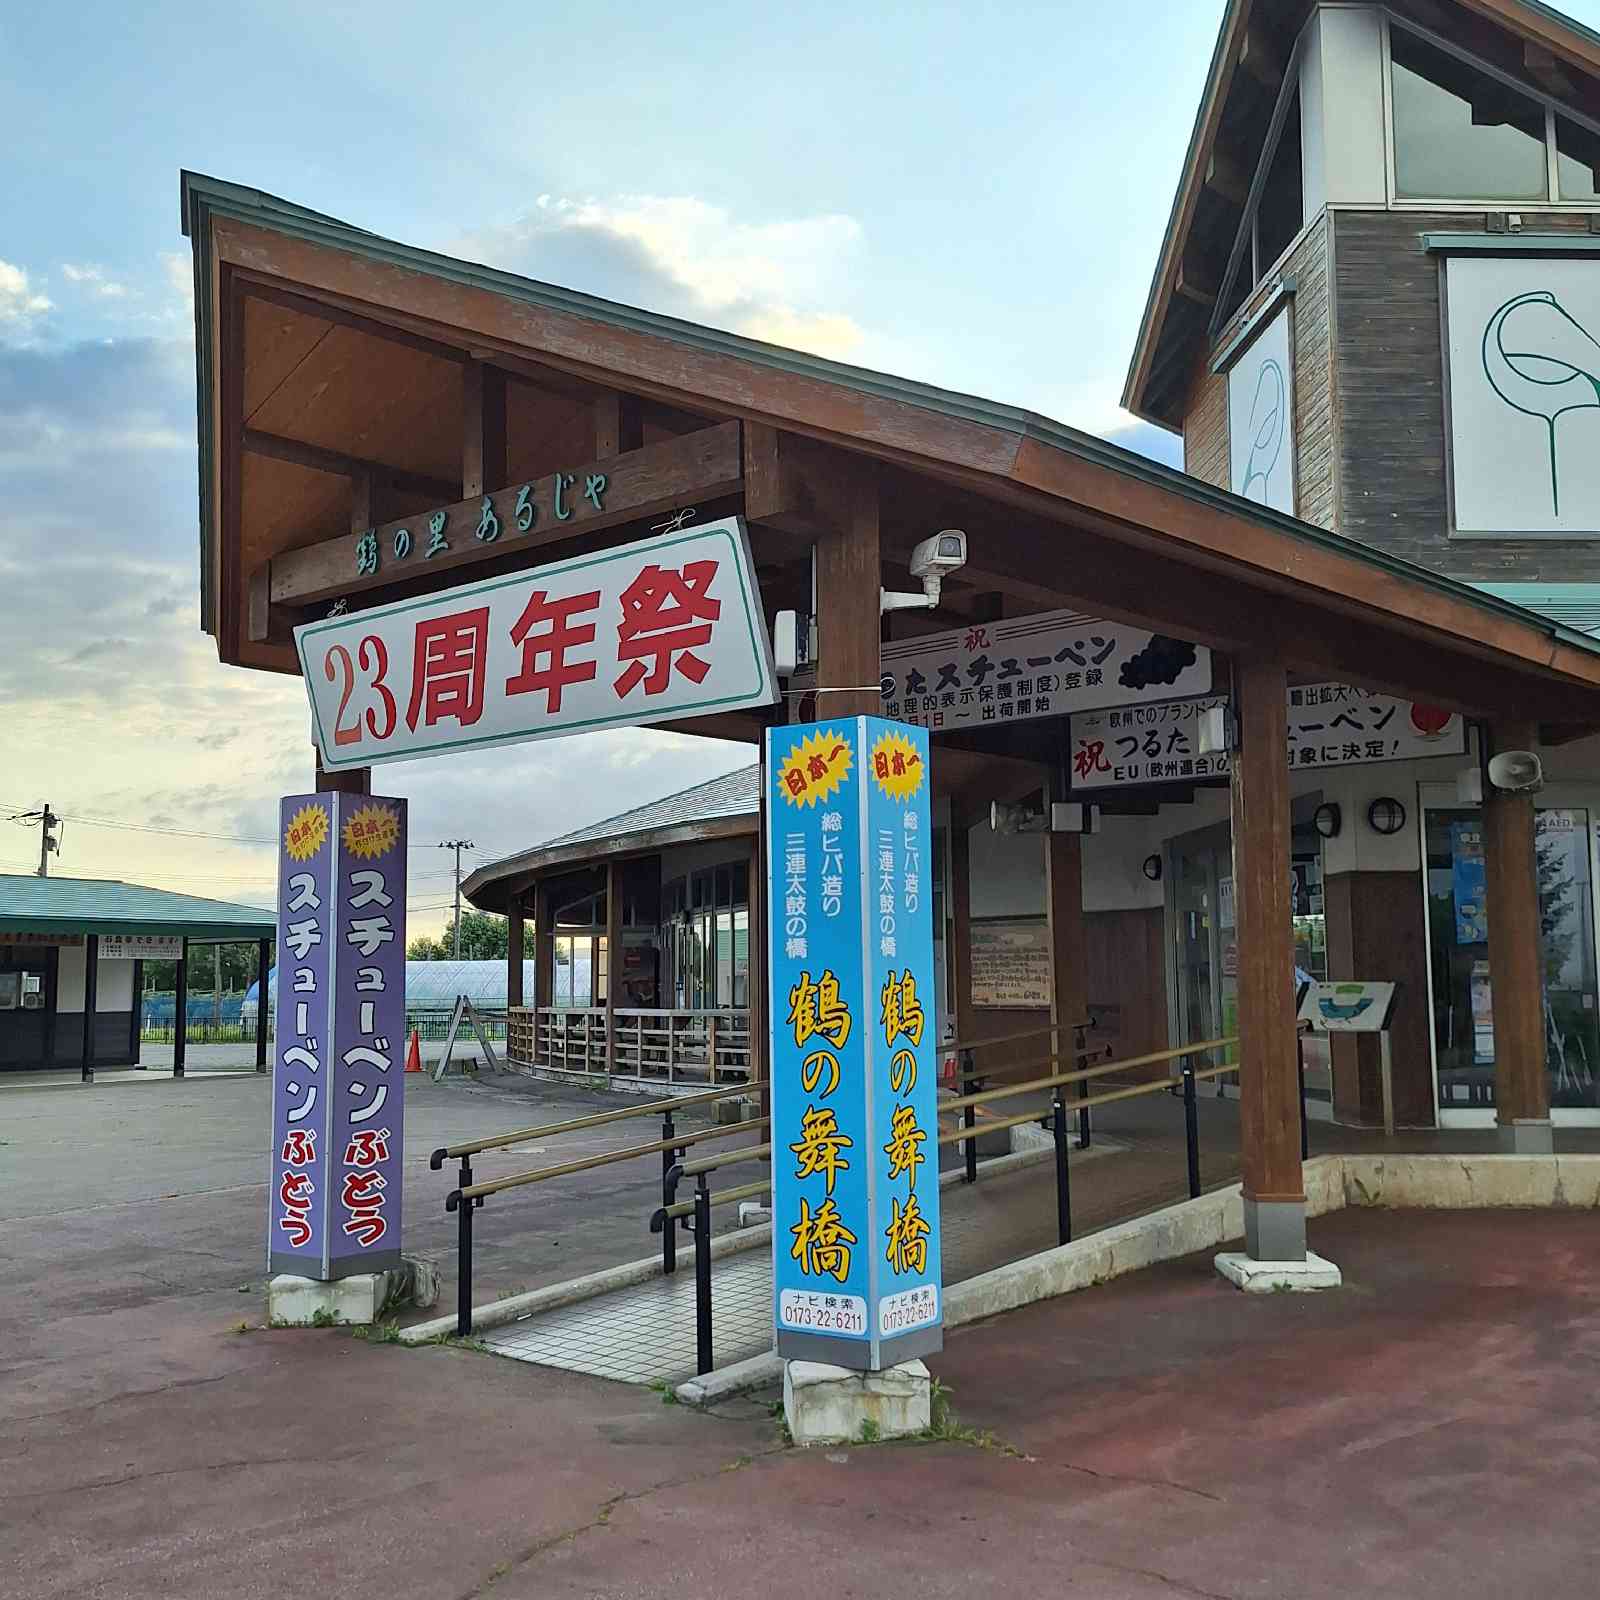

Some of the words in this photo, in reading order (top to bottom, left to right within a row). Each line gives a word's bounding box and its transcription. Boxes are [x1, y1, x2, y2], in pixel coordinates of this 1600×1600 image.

[323, 559, 722, 747] 23周年祭
[964, 627, 991, 651] 祝
[1110, 699, 1218, 729] 欧州でのブランド
[1115, 727, 1190, 758] つるた
[1288, 705, 1396, 741] ーベン
[784, 744, 846, 797] 日本一
[874, 748, 920, 780] 日本一
[1073, 738, 1112, 780] 祝
[821, 812, 843, 917] 総ヒバ造り
[903, 810, 919, 913] 総ヒバ造り
[785, 832, 808, 959] 三連太鼓の橋
[879, 829, 896, 957] 三連太鼓の橋
[786, 969, 857, 1283] 鶴の舞橋
[880, 968, 931, 1275] 鶴の舞橋
[785, 1305, 862, 1331] 0173-22-6211
[792, 1292, 854, 1310] ナビ検索
[884, 1302, 935, 1331] 0173-22-6211
